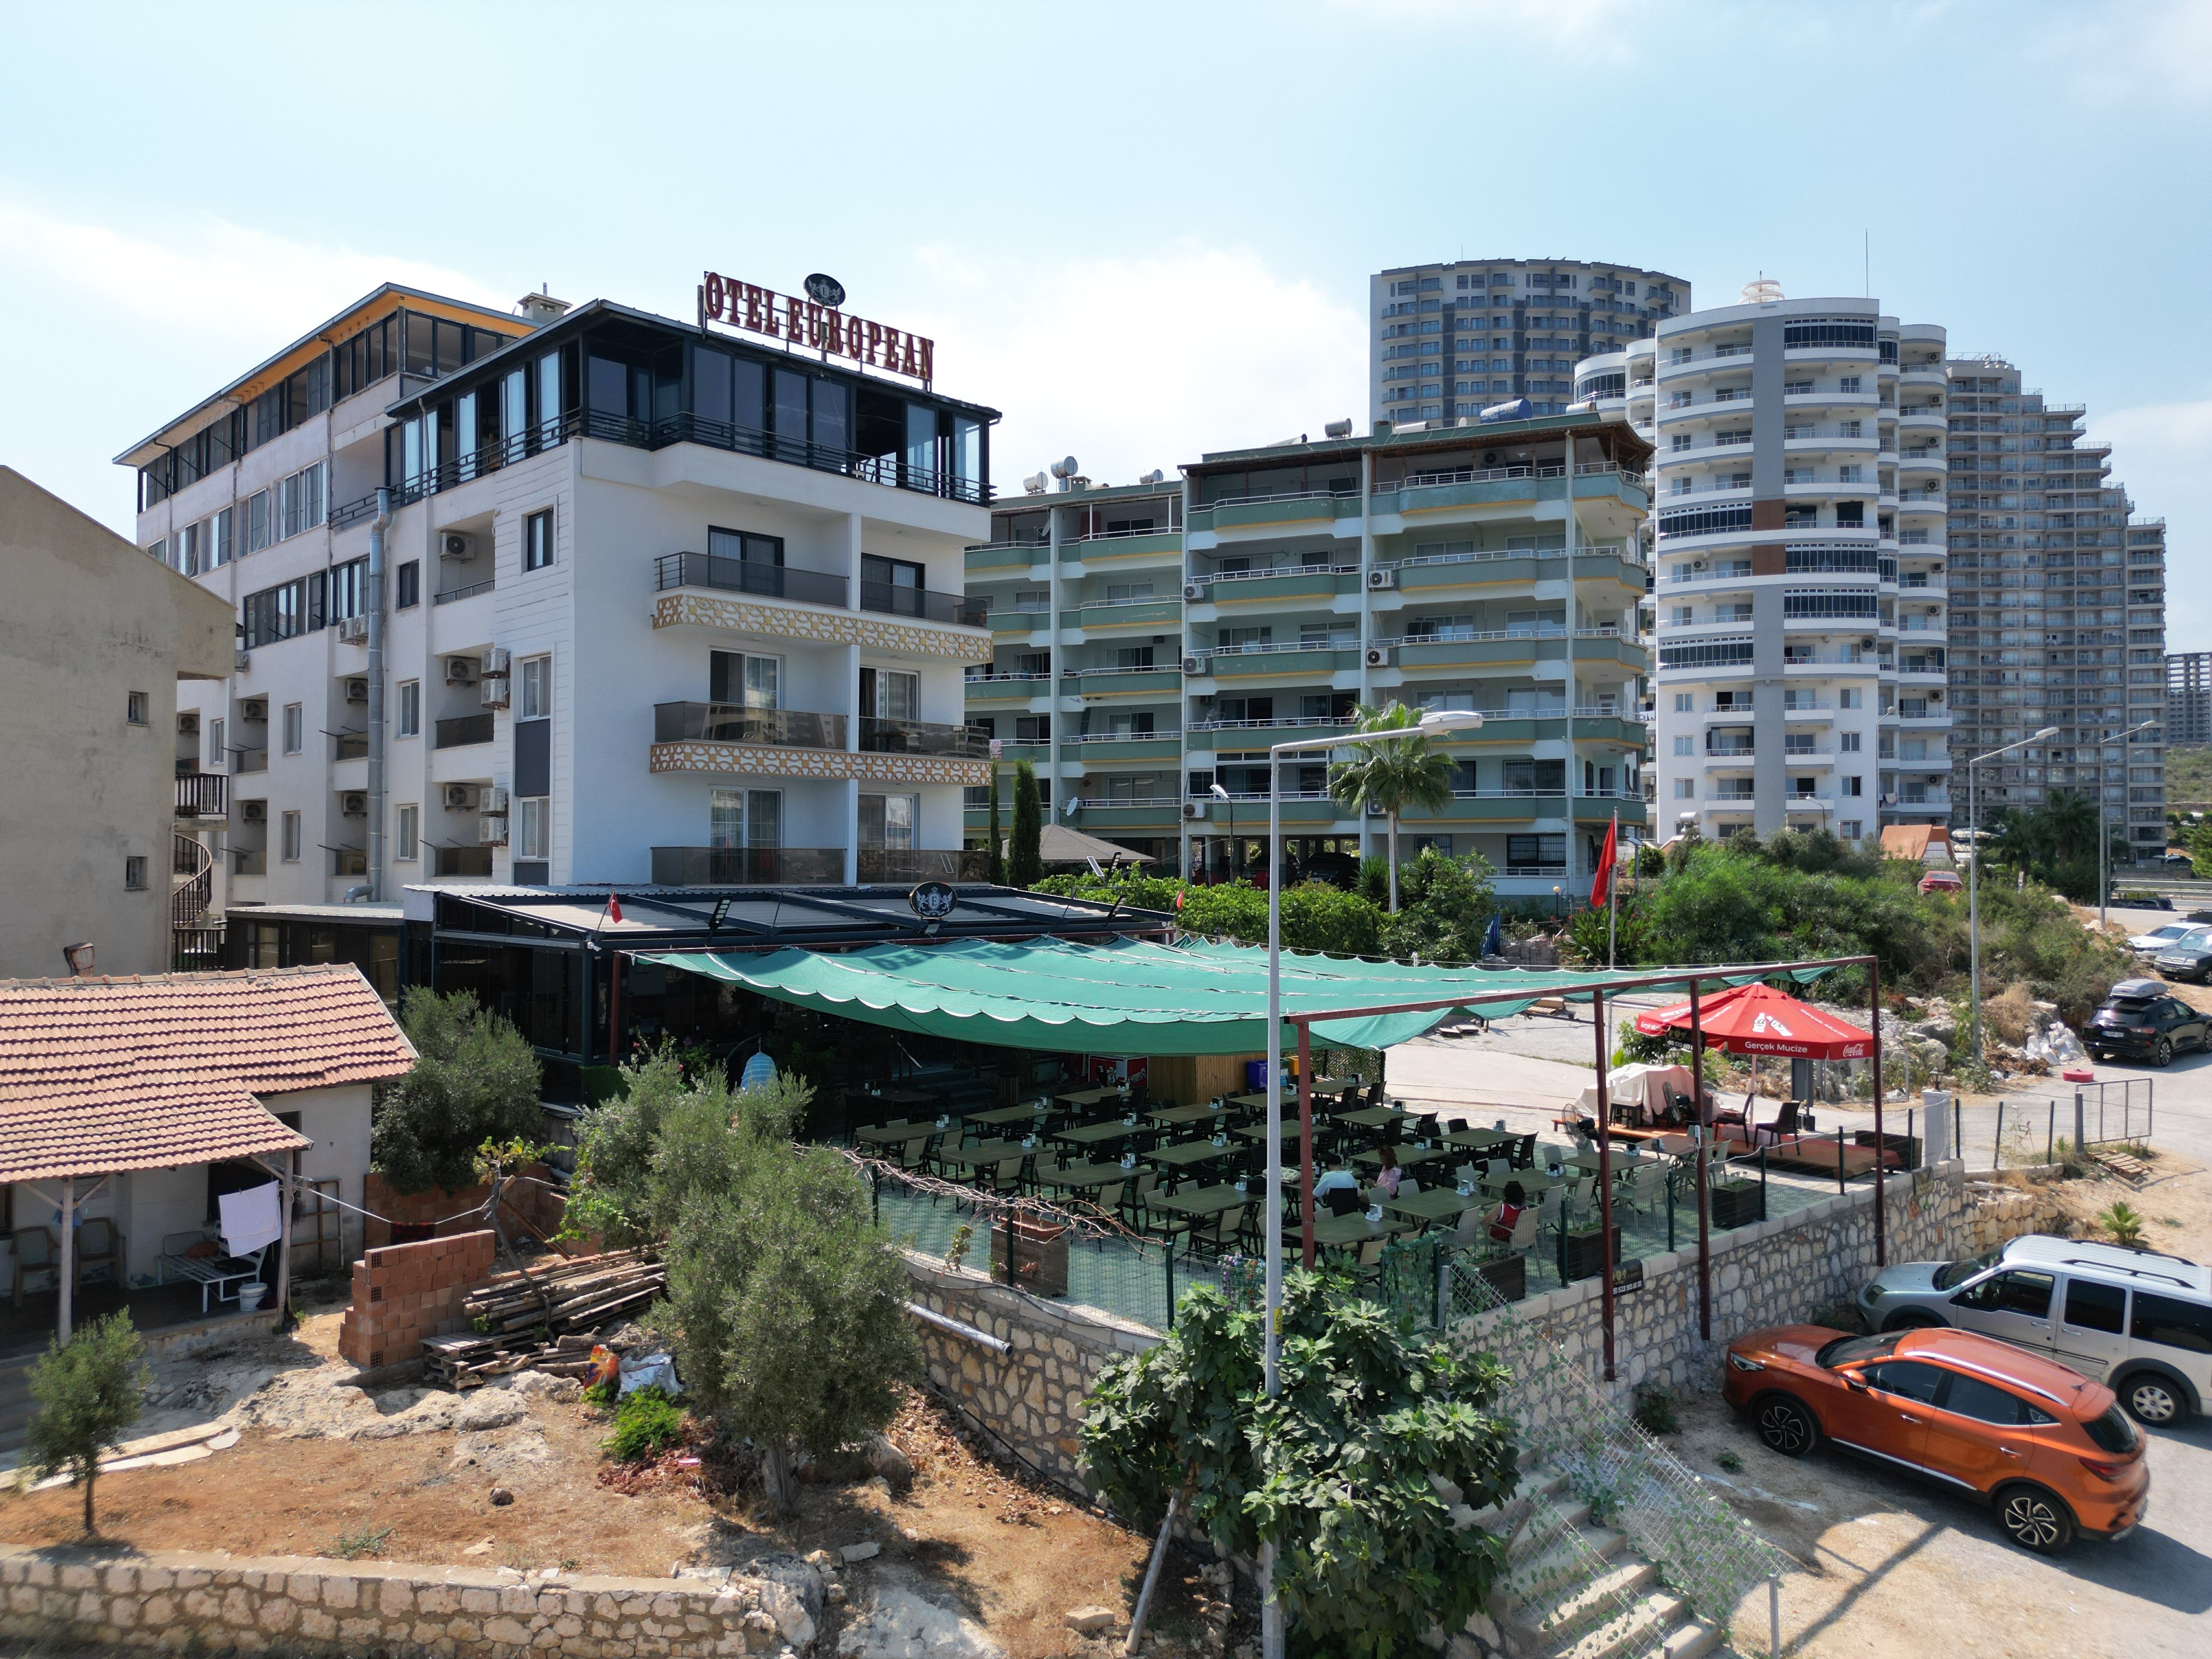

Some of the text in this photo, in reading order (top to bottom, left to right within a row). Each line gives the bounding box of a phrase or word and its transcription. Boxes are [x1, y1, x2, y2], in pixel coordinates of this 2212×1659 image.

[704, 271, 934, 380] OTEL EUROPEAN
[931, 896, 937, 906] E
[1745, 1041, 1808, 1053] Gerçek Mucize
